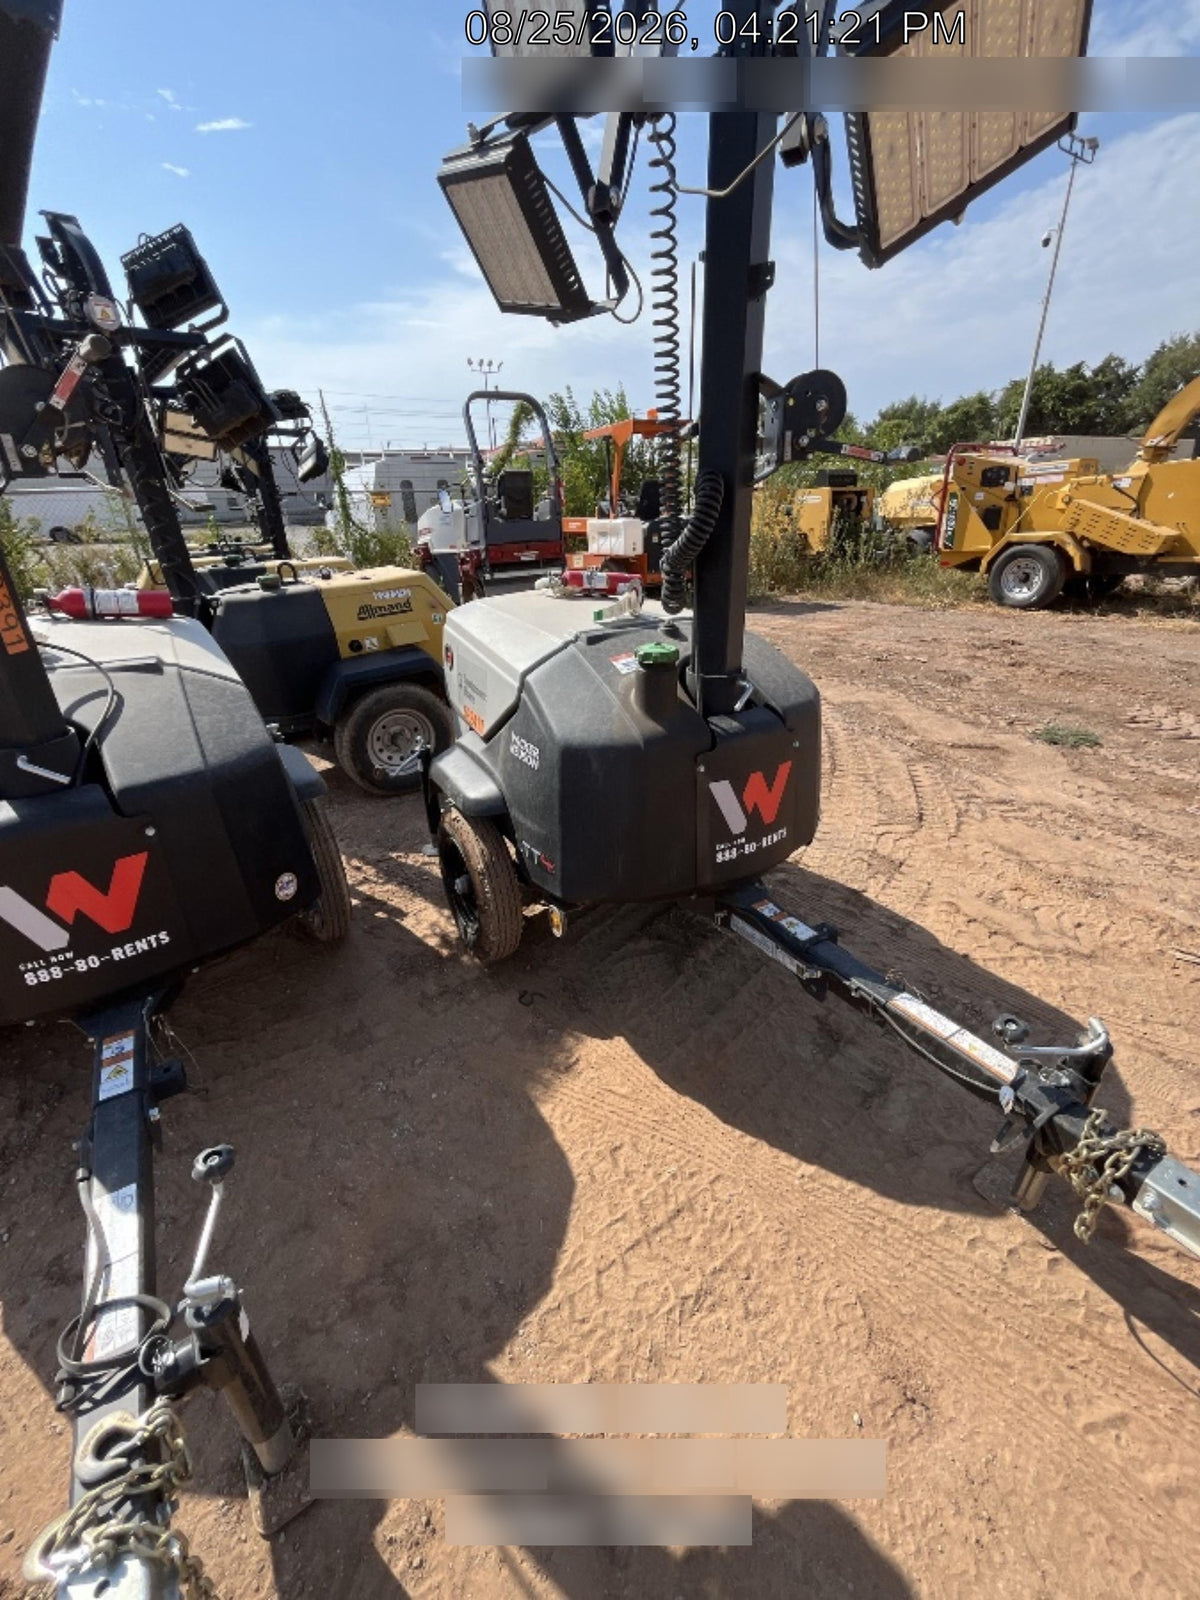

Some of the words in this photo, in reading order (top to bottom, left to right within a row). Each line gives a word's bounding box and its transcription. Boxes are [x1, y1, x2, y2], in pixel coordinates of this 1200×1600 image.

[18, 957, 47, 972] CALL
[50, 950, 74, 964] NOW
[24, 930, 171, 986] 888-80-RENTS
